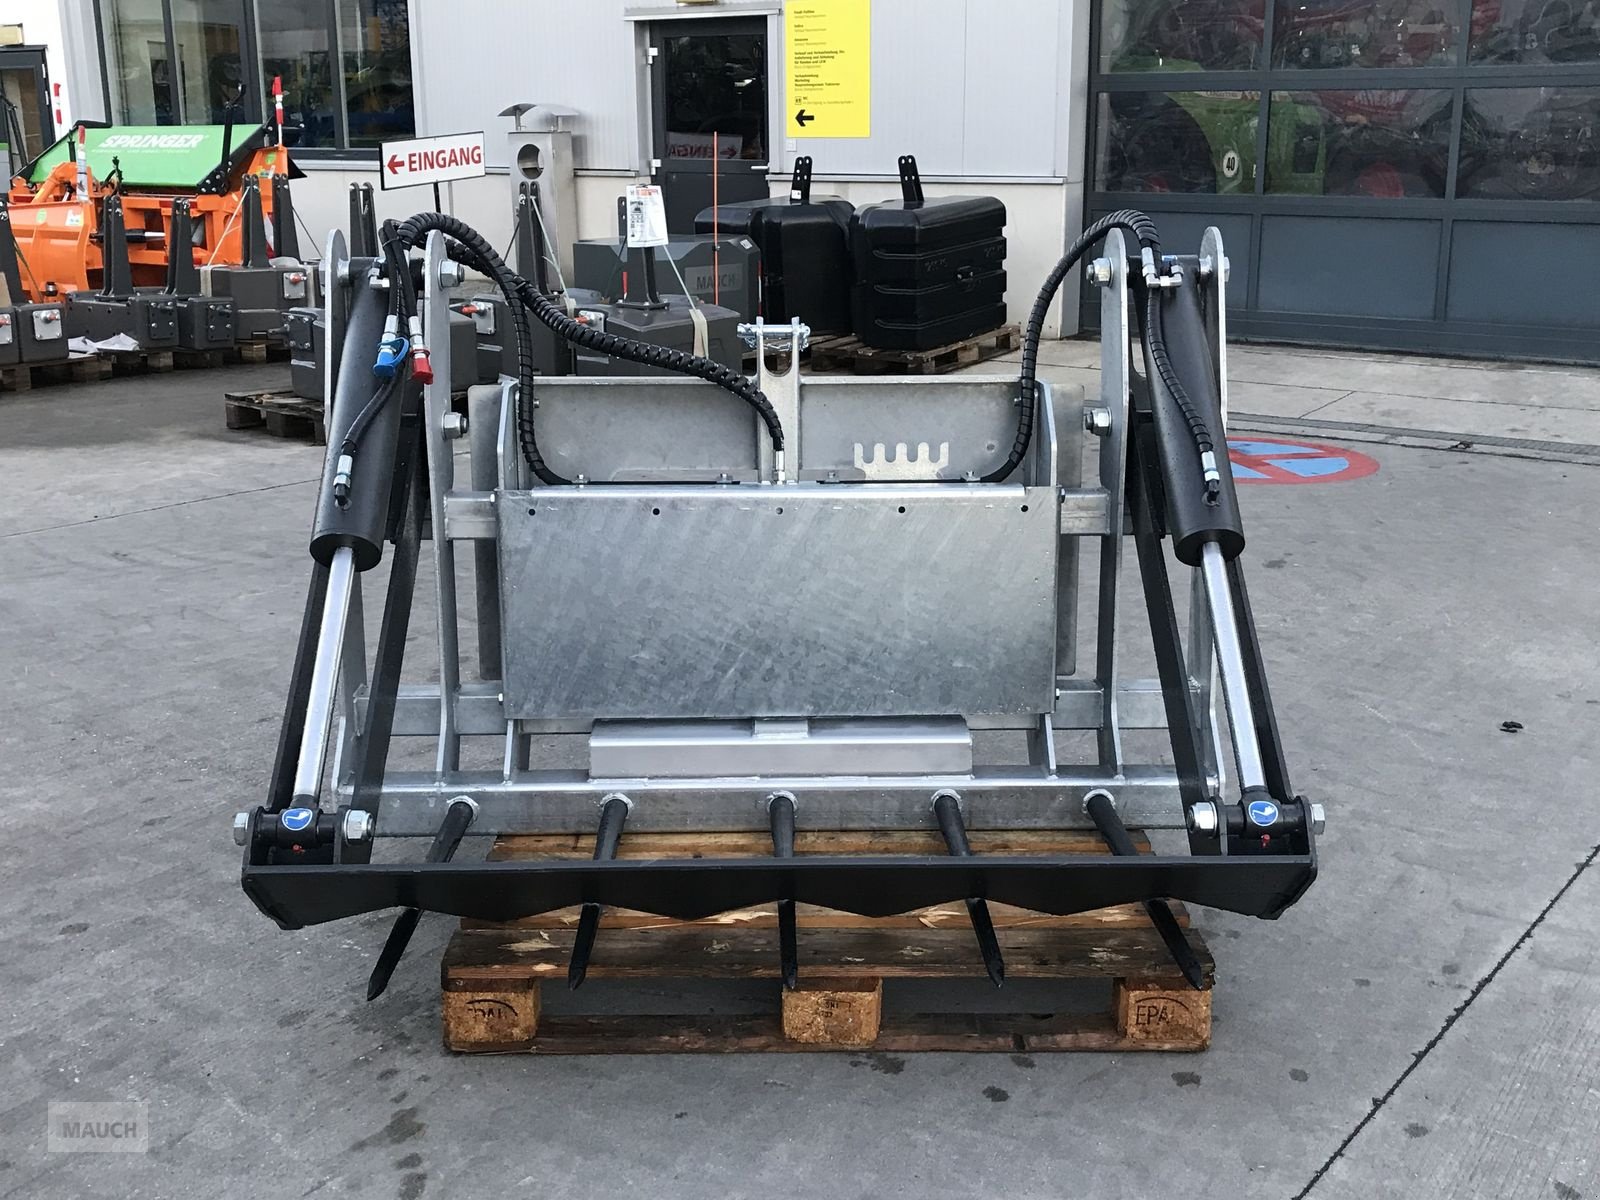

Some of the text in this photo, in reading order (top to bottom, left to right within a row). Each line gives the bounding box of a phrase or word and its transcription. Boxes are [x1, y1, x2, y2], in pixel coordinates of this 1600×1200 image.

[98, 134, 205, 149] SPRINGER
[408, 145, 483, 173] EINGANG
[1226, 156, 1236, 172] 40
[696, 273, 736, 291] MACH
[1135, 1003, 1177, 1026] EPA
